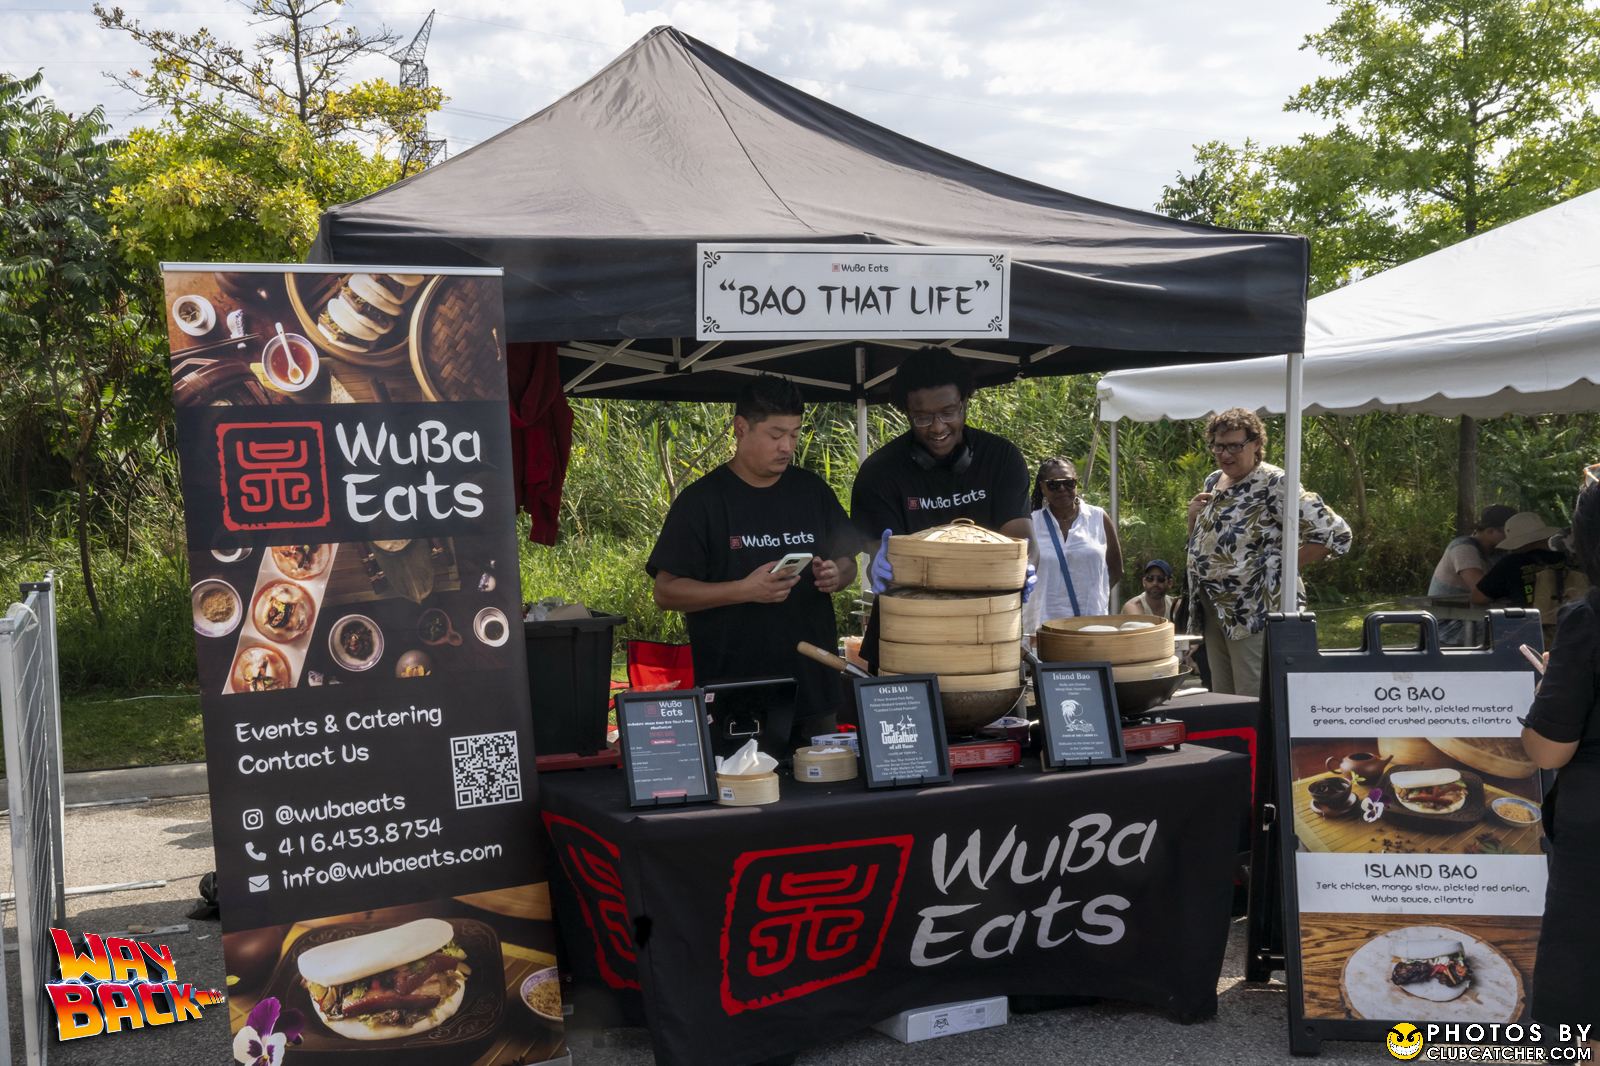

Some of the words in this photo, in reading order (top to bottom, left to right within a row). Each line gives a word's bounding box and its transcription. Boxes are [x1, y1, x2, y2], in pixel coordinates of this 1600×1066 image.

[841, 263, 865, 272] WuBa
[868, 263, 889, 272] Eats
[817, 285, 900, 315] THAT
[335, 420, 481, 467] WuBa
[341, 470, 484, 523] Eats
[918, 497, 951, 510] WuBa
[953, 489, 986, 506] Eats
[741, 534, 780, 548] WuBa
[783, 531, 815, 545] Eats
[1053, 672, 1074, 681] Island
[879, 686, 891, 694] OG
[891, 685, 908, 693] BAO
[1374, 686, 1401, 700] OG
[1407, 686, 1445, 701] BAO
[660, 708, 683, 717] Eats
[1310, 705, 1342, 713] 8-hour
[1344, 705, 1380, 713] braised
[1382, 705, 1403, 714] pork
[1434, 704, 1469, 714] pickled
[1472, 705, 1513, 713] mustard
[235, 717, 318, 743] Events
[324, 714, 340, 733] &
[346, 705, 442, 731] Catering
[879, 720, 894, 734] The
[1313, 717, 1347, 726] greens,
[1349, 717, 1386, 725] candied
[1388, 717, 1425, 725] crushed
[1428, 717, 1469, 726] peanuts,
[1472, 717, 1512, 725] cilantro
[881, 730, 919, 744] Godfather
[238, 746, 336, 775] Contact
[342, 744, 370, 763] Us
[275, 793, 406, 825] @wubaeats
[278, 817, 444, 857] 416.453.8754
[931, 813, 1158, 895] WuBa
[282, 842, 503, 890] info@wubaeats.com
[1364, 863, 1433, 879] ISLAND
[1439, 864, 1478, 880] BAO
[1316, 882, 1338, 891] Jerk
[1340, 882, 1380, 892] chicken,
[1382, 884, 1413, 893] mango
[1443, 883, 1480, 893] pickled
[1481, 884, 1499, 892] red
[1501, 884, 1530, 893] onion,
[1371, 895, 1398, 904] Wuba
[1401, 896, 1432, 905] sauce,
[1434, 895, 1474, 904] cilantro
[910, 886, 1131, 967] Eats
